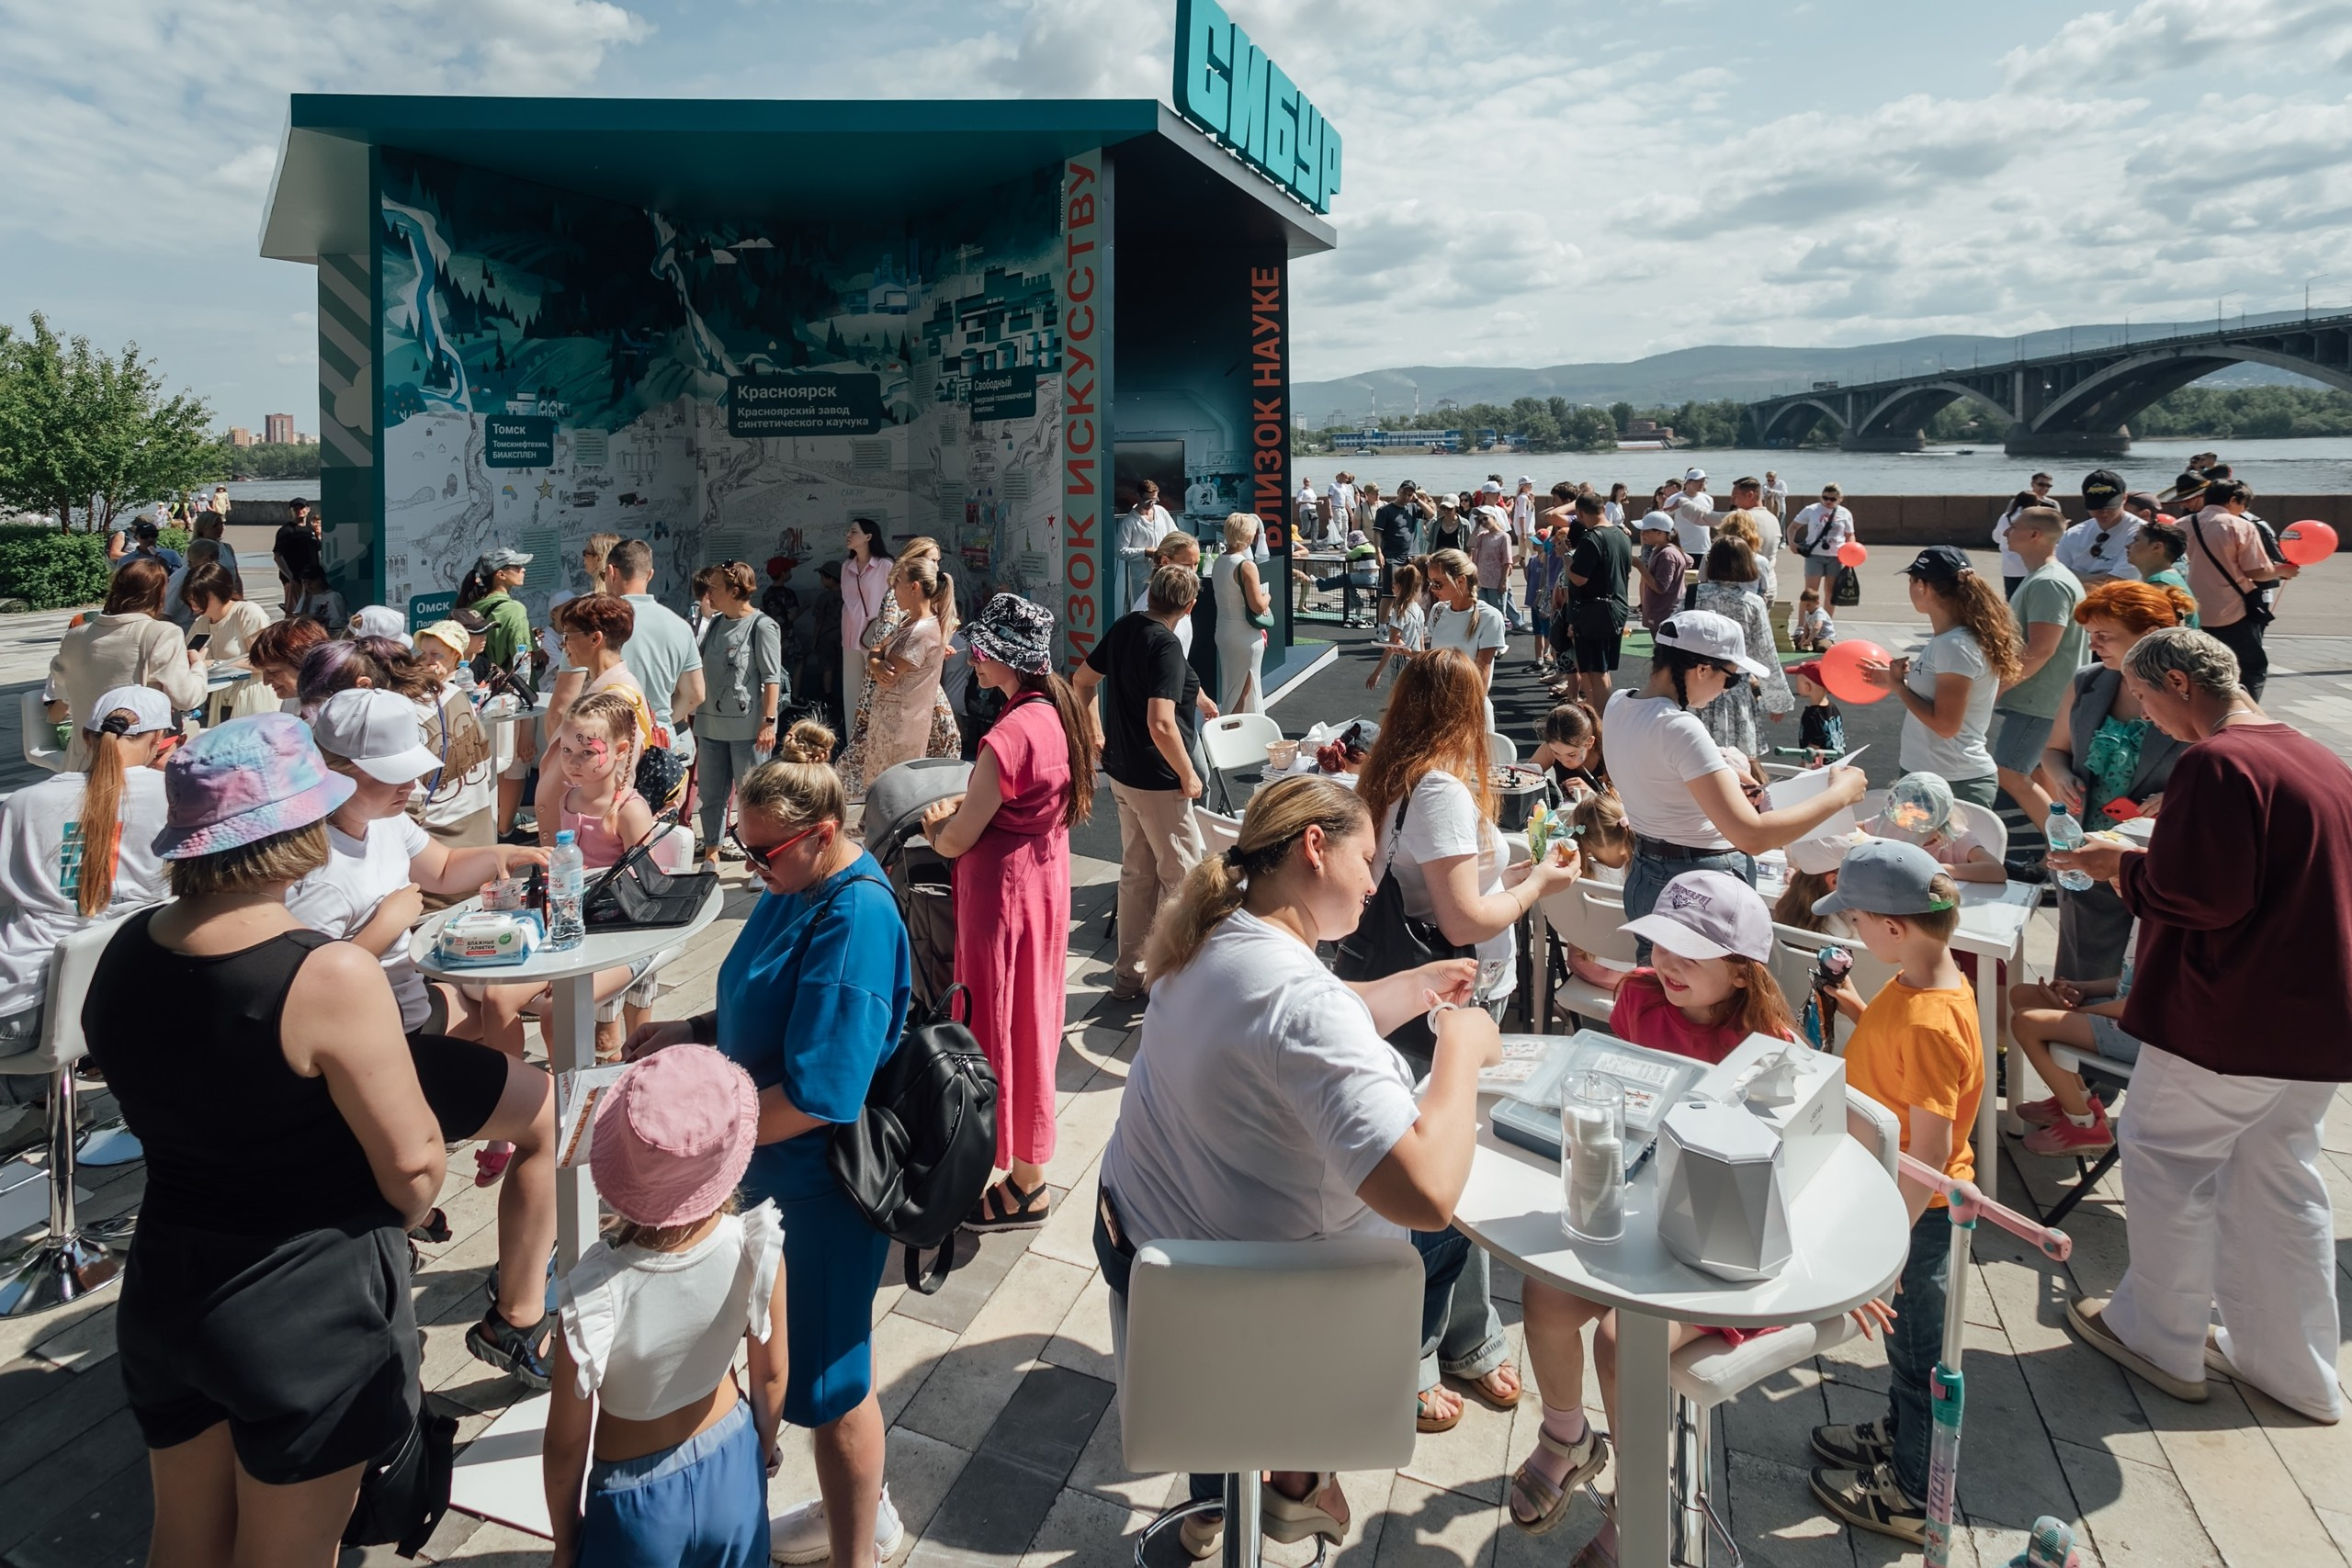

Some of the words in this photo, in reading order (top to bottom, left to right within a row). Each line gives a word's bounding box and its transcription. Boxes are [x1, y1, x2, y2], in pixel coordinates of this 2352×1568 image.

[1174, 0, 1342, 215] СИБУР
[1066, 162, 1096, 495] ИСКУССТВУ
[1251, 266, 1281, 387] НАУКЕ
[974, 375, 1012, 391] Свободный
[737, 385, 837, 402] Красноярск
[737, 405, 816, 419] Красноярский
[818, 406, 851, 416] завод
[492, 423, 526, 434] Томск
[737, 418, 824, 429] синтетического
[826, 417, 869, 428] каучука
[492, 450, 537, 459] БИАКСПЛЕН
[1066, 513, 1096, 686] ИЗОК
[416, 602, 450, 615] Омск
